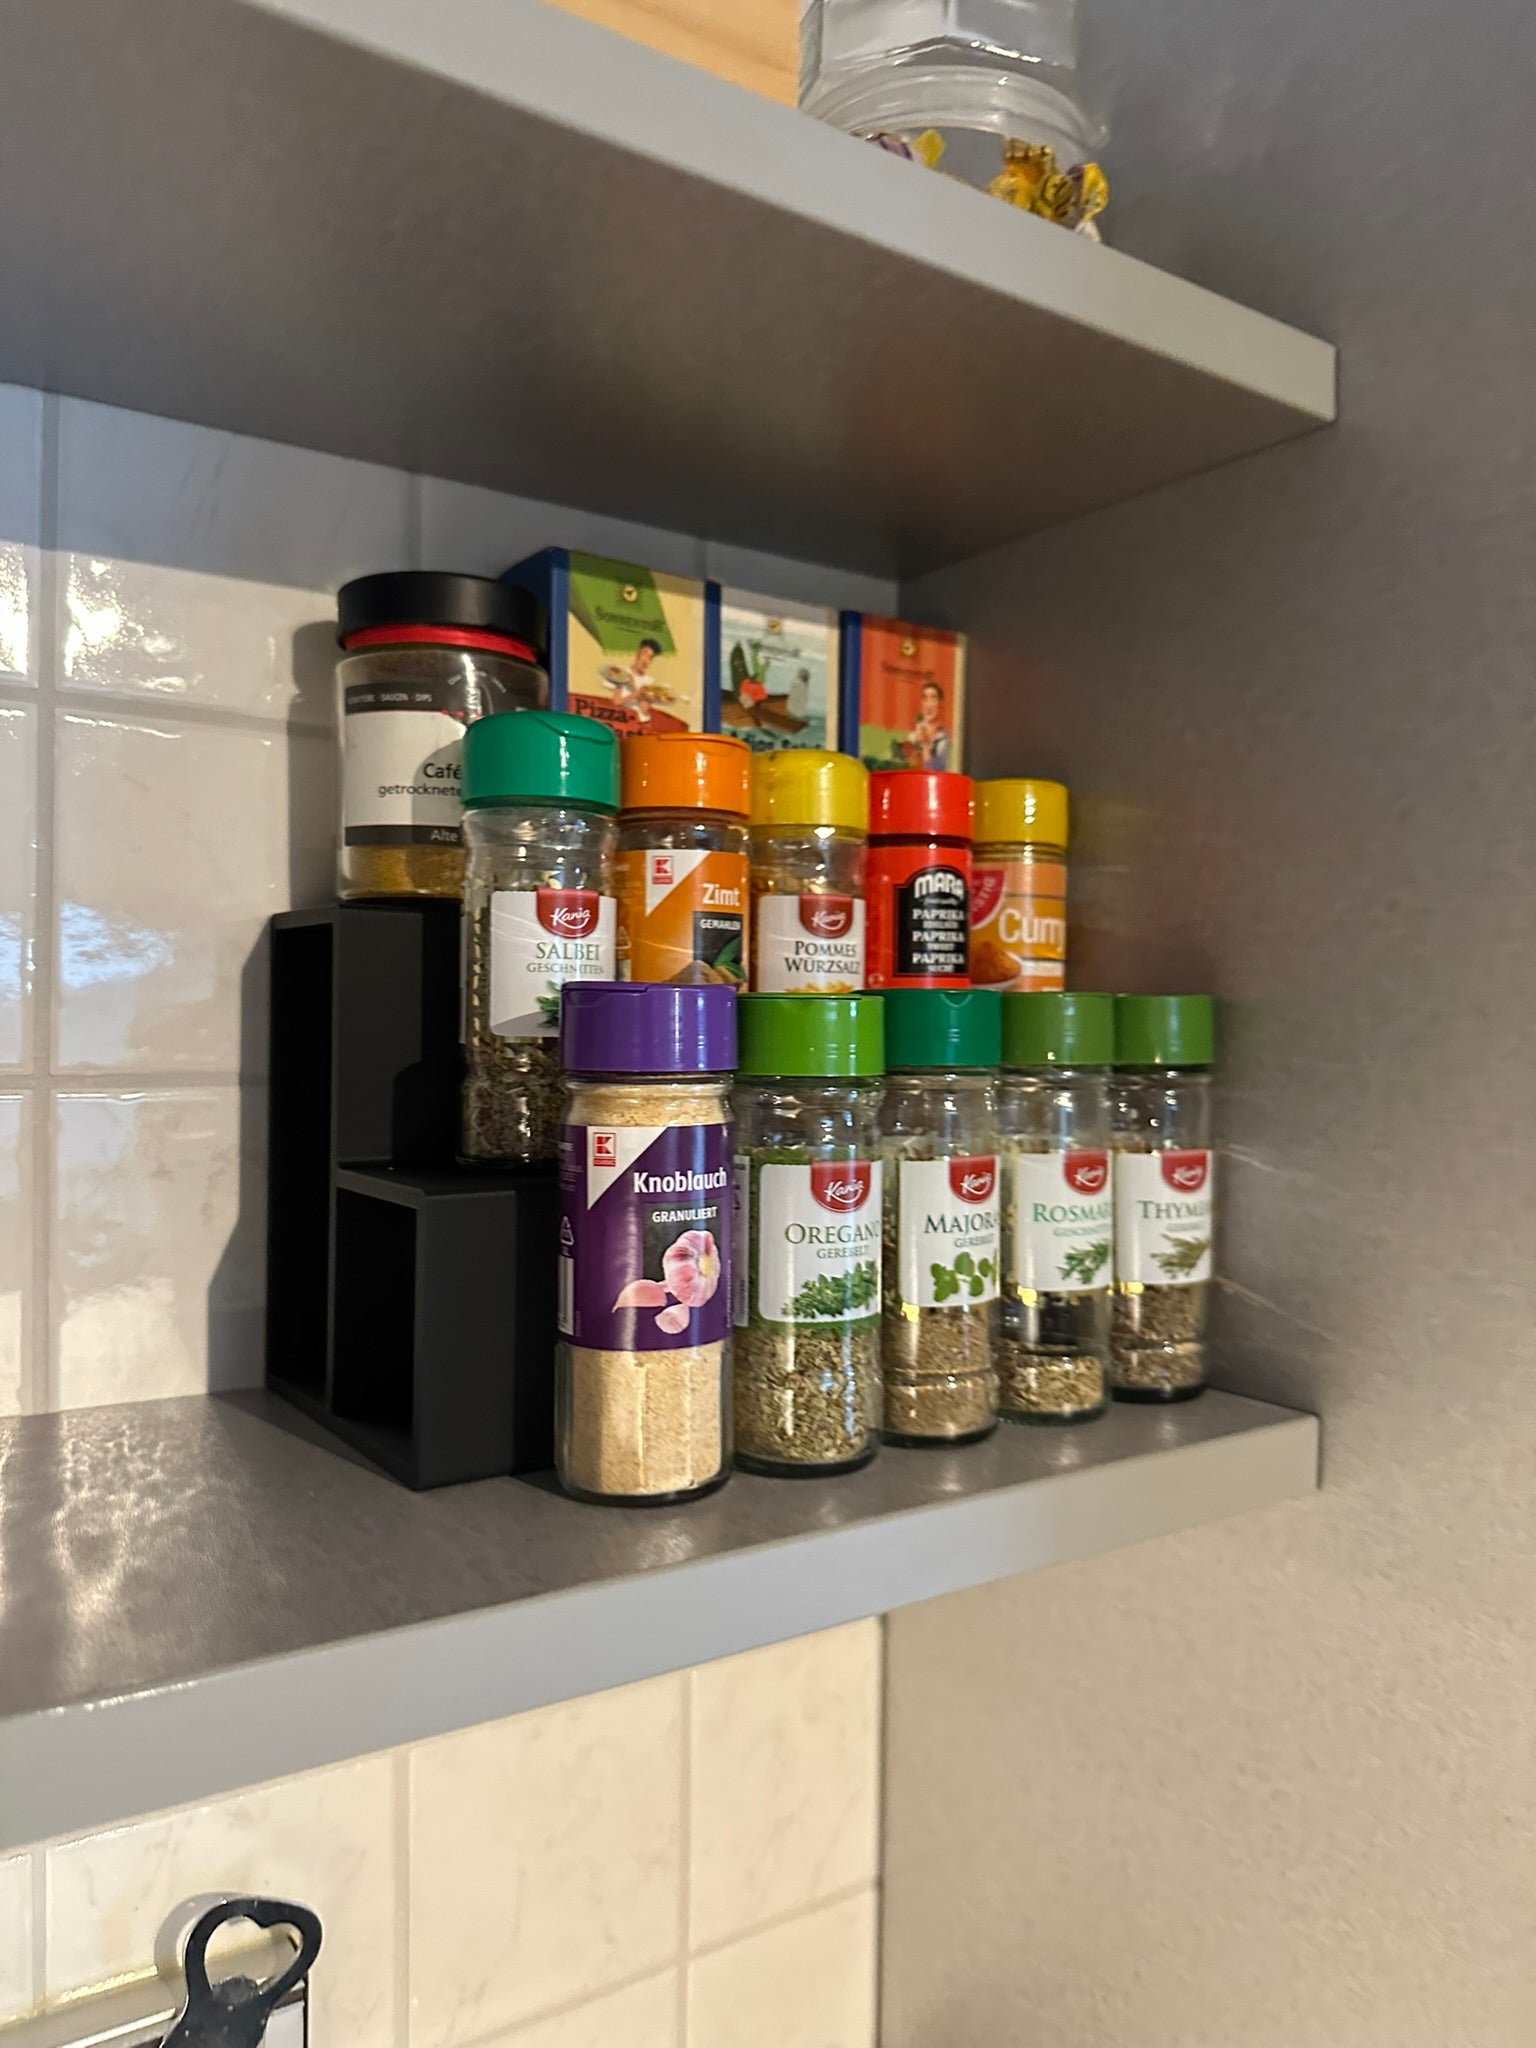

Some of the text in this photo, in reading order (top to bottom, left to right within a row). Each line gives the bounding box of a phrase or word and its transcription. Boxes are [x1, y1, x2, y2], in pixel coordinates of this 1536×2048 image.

[423, 763, 463, 780] Café
[702, 883, 740, 907] Zimt
[550, 907, 592, 930] Kania
[536, 942, 600, 960] SALBEI
[795, 941, 856, 957] POMMES
[633, 1166, 728, 1193] Knoblauch
[824, 1179, 864, 1204] Kania
[652, 1206, 718, 1223] GRANULIERT
